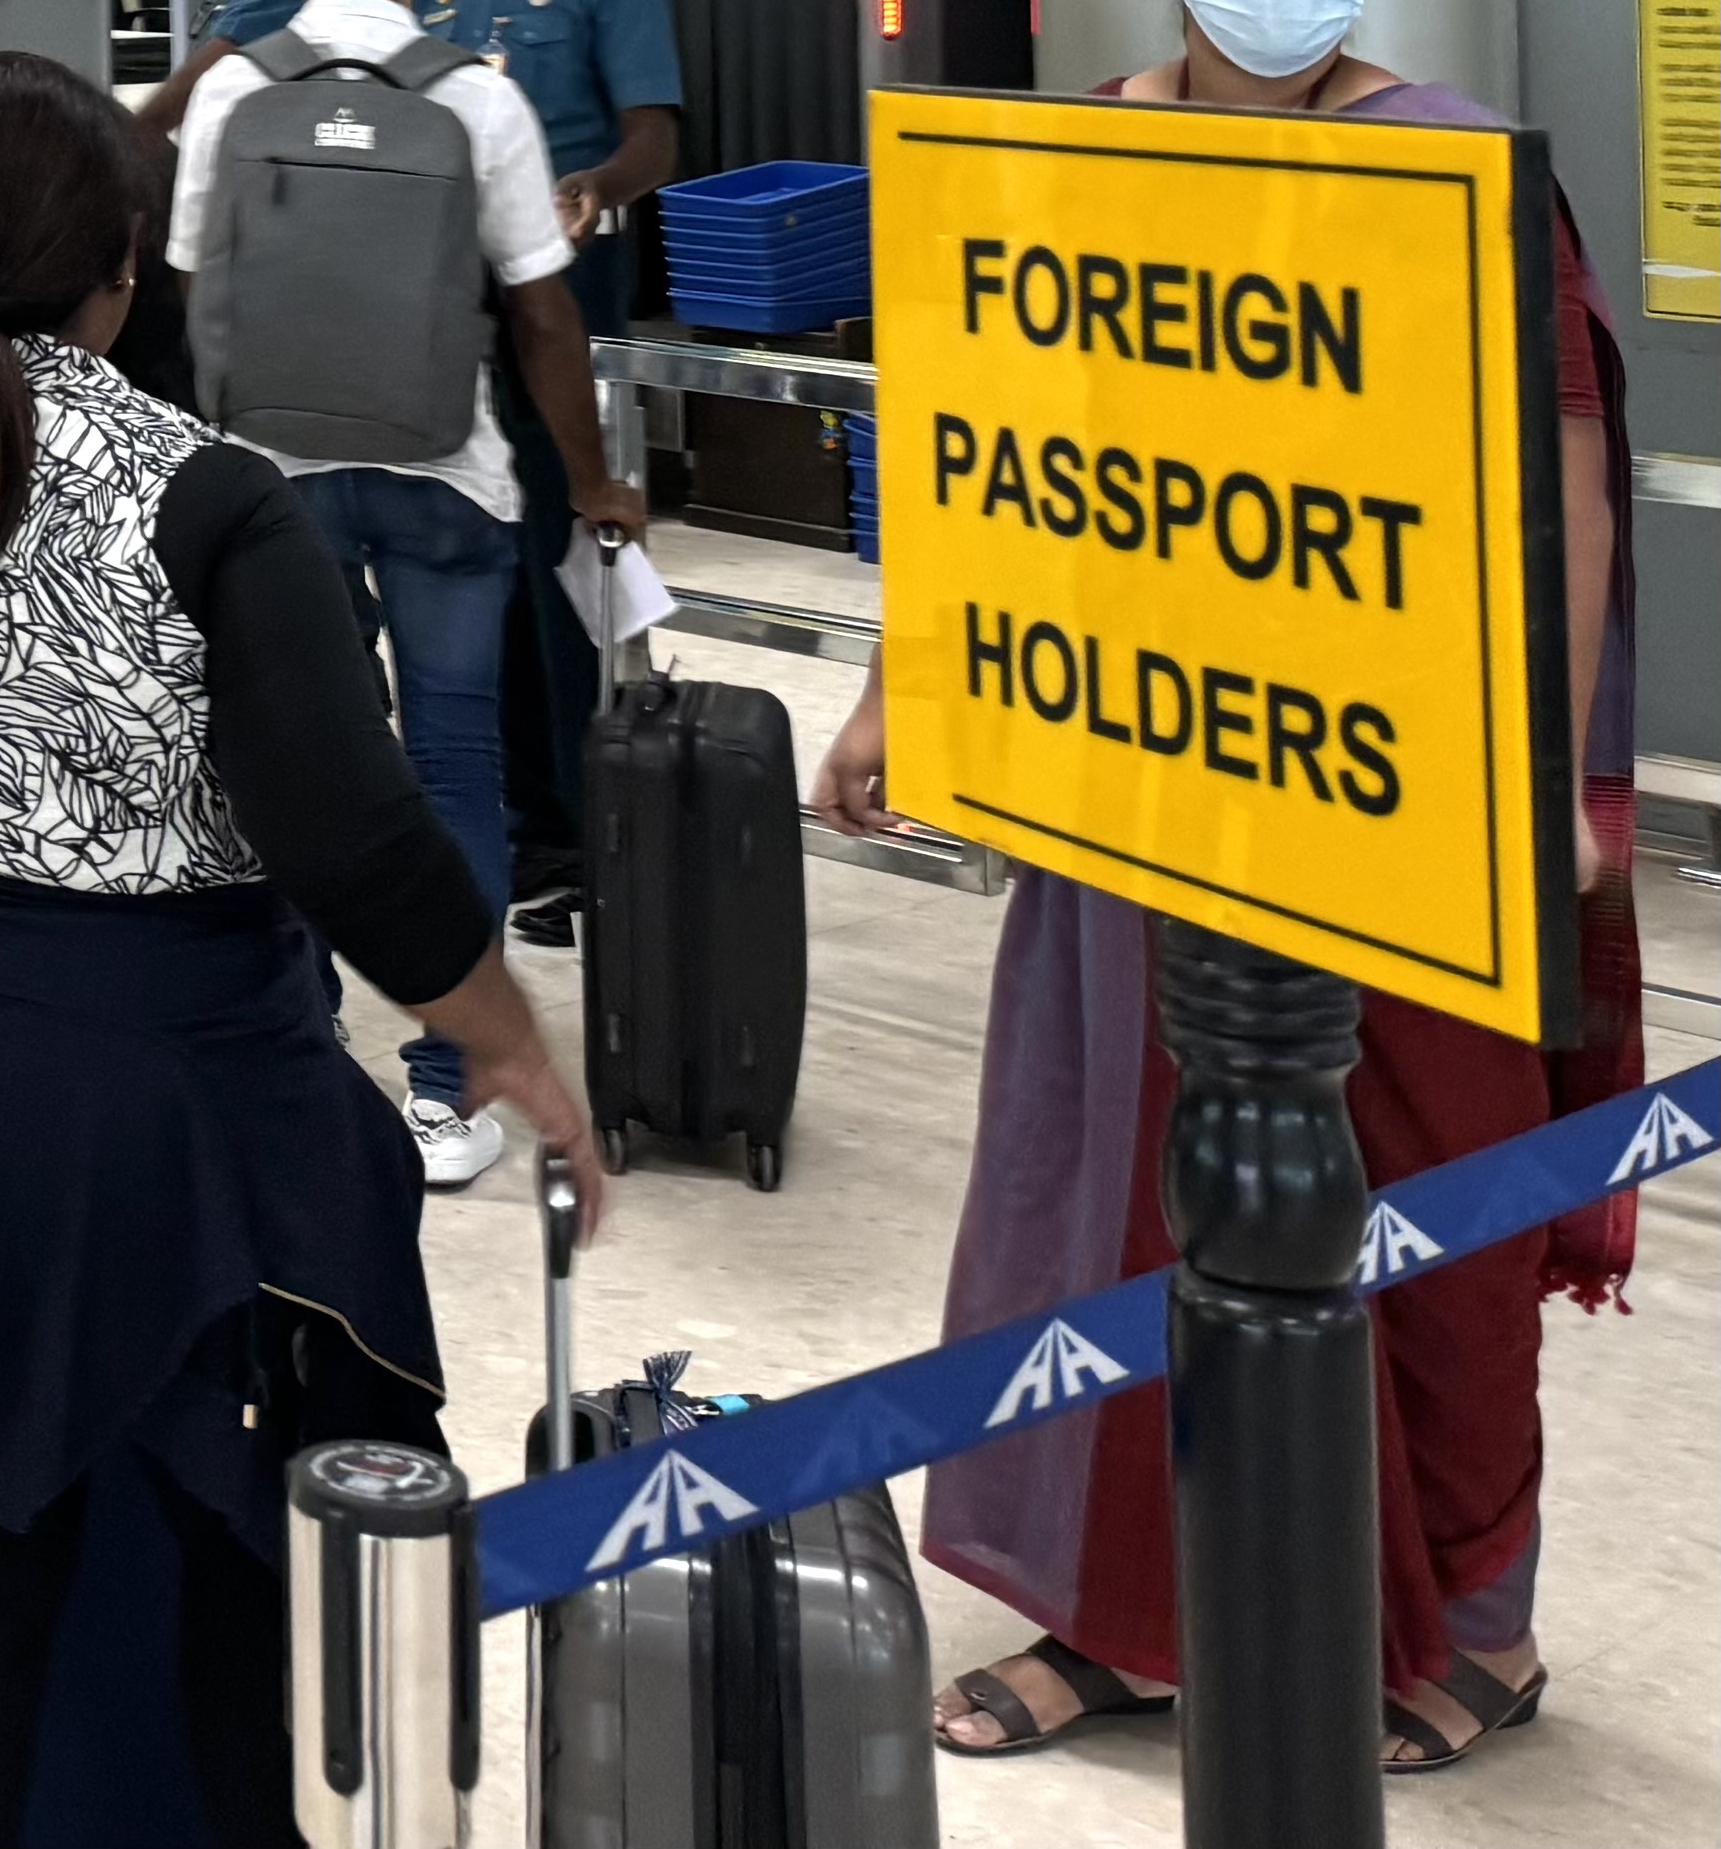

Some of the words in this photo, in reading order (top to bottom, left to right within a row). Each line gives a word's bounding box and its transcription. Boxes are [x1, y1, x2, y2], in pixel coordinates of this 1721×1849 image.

[961, 238, 1365, 395] FOREIGN
[933, 411, 1424, 611] PASSPORT
[965, 601, 1402, 818] HOLDERS
